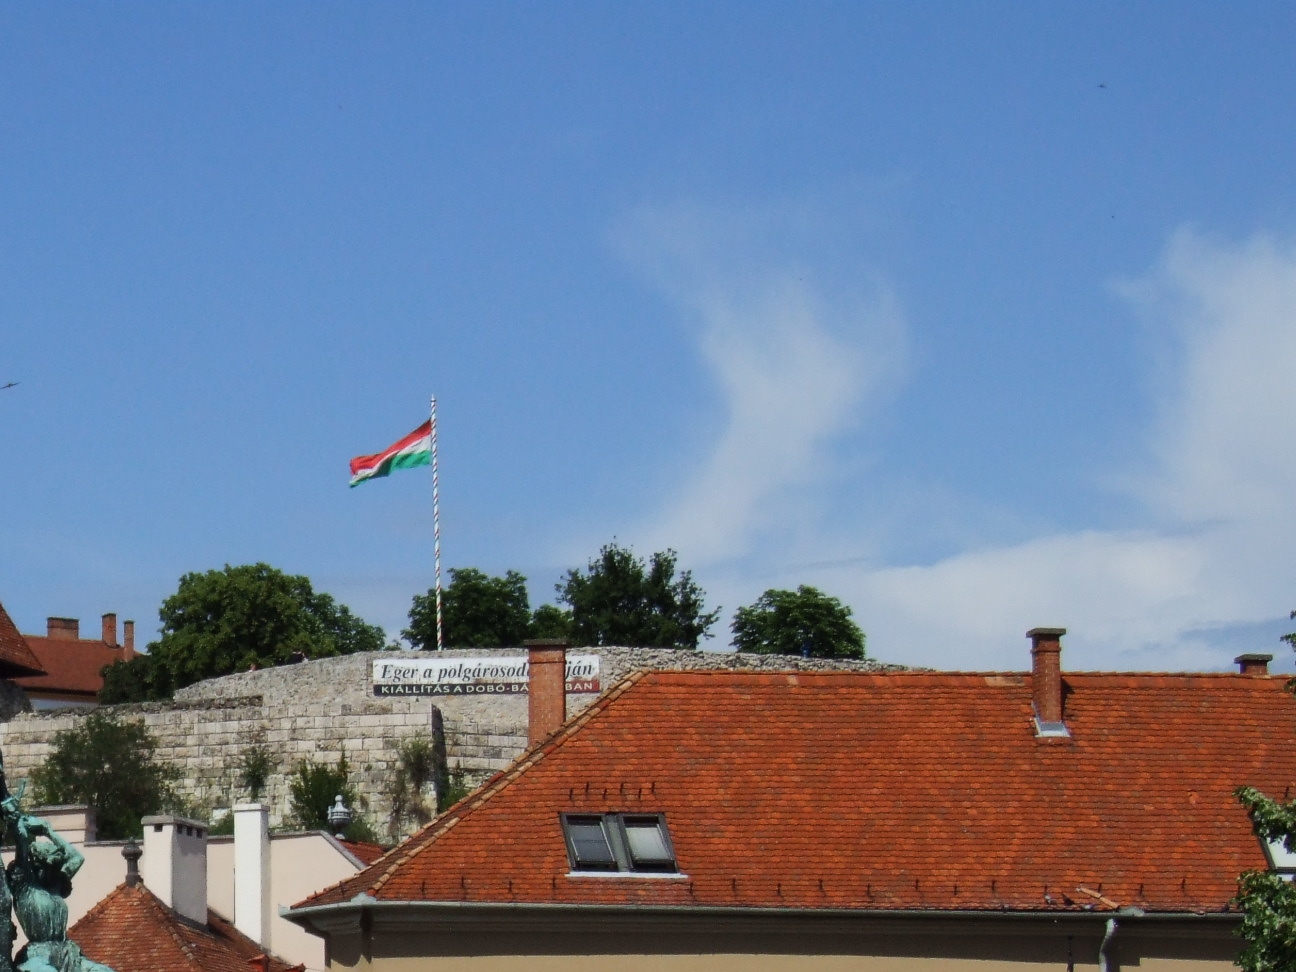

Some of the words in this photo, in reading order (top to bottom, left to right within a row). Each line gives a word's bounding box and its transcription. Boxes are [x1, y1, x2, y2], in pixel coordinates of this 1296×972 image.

[381, 664, 419, 682] Eger
[423, 667, 432, 679] a
[437, 662, 529, 682] polgárosod
[565, 660, 592, 679] ján
[381, 684, 450, 694] KIÁLLÍTÁS
[453, 685, 462, 693] A
